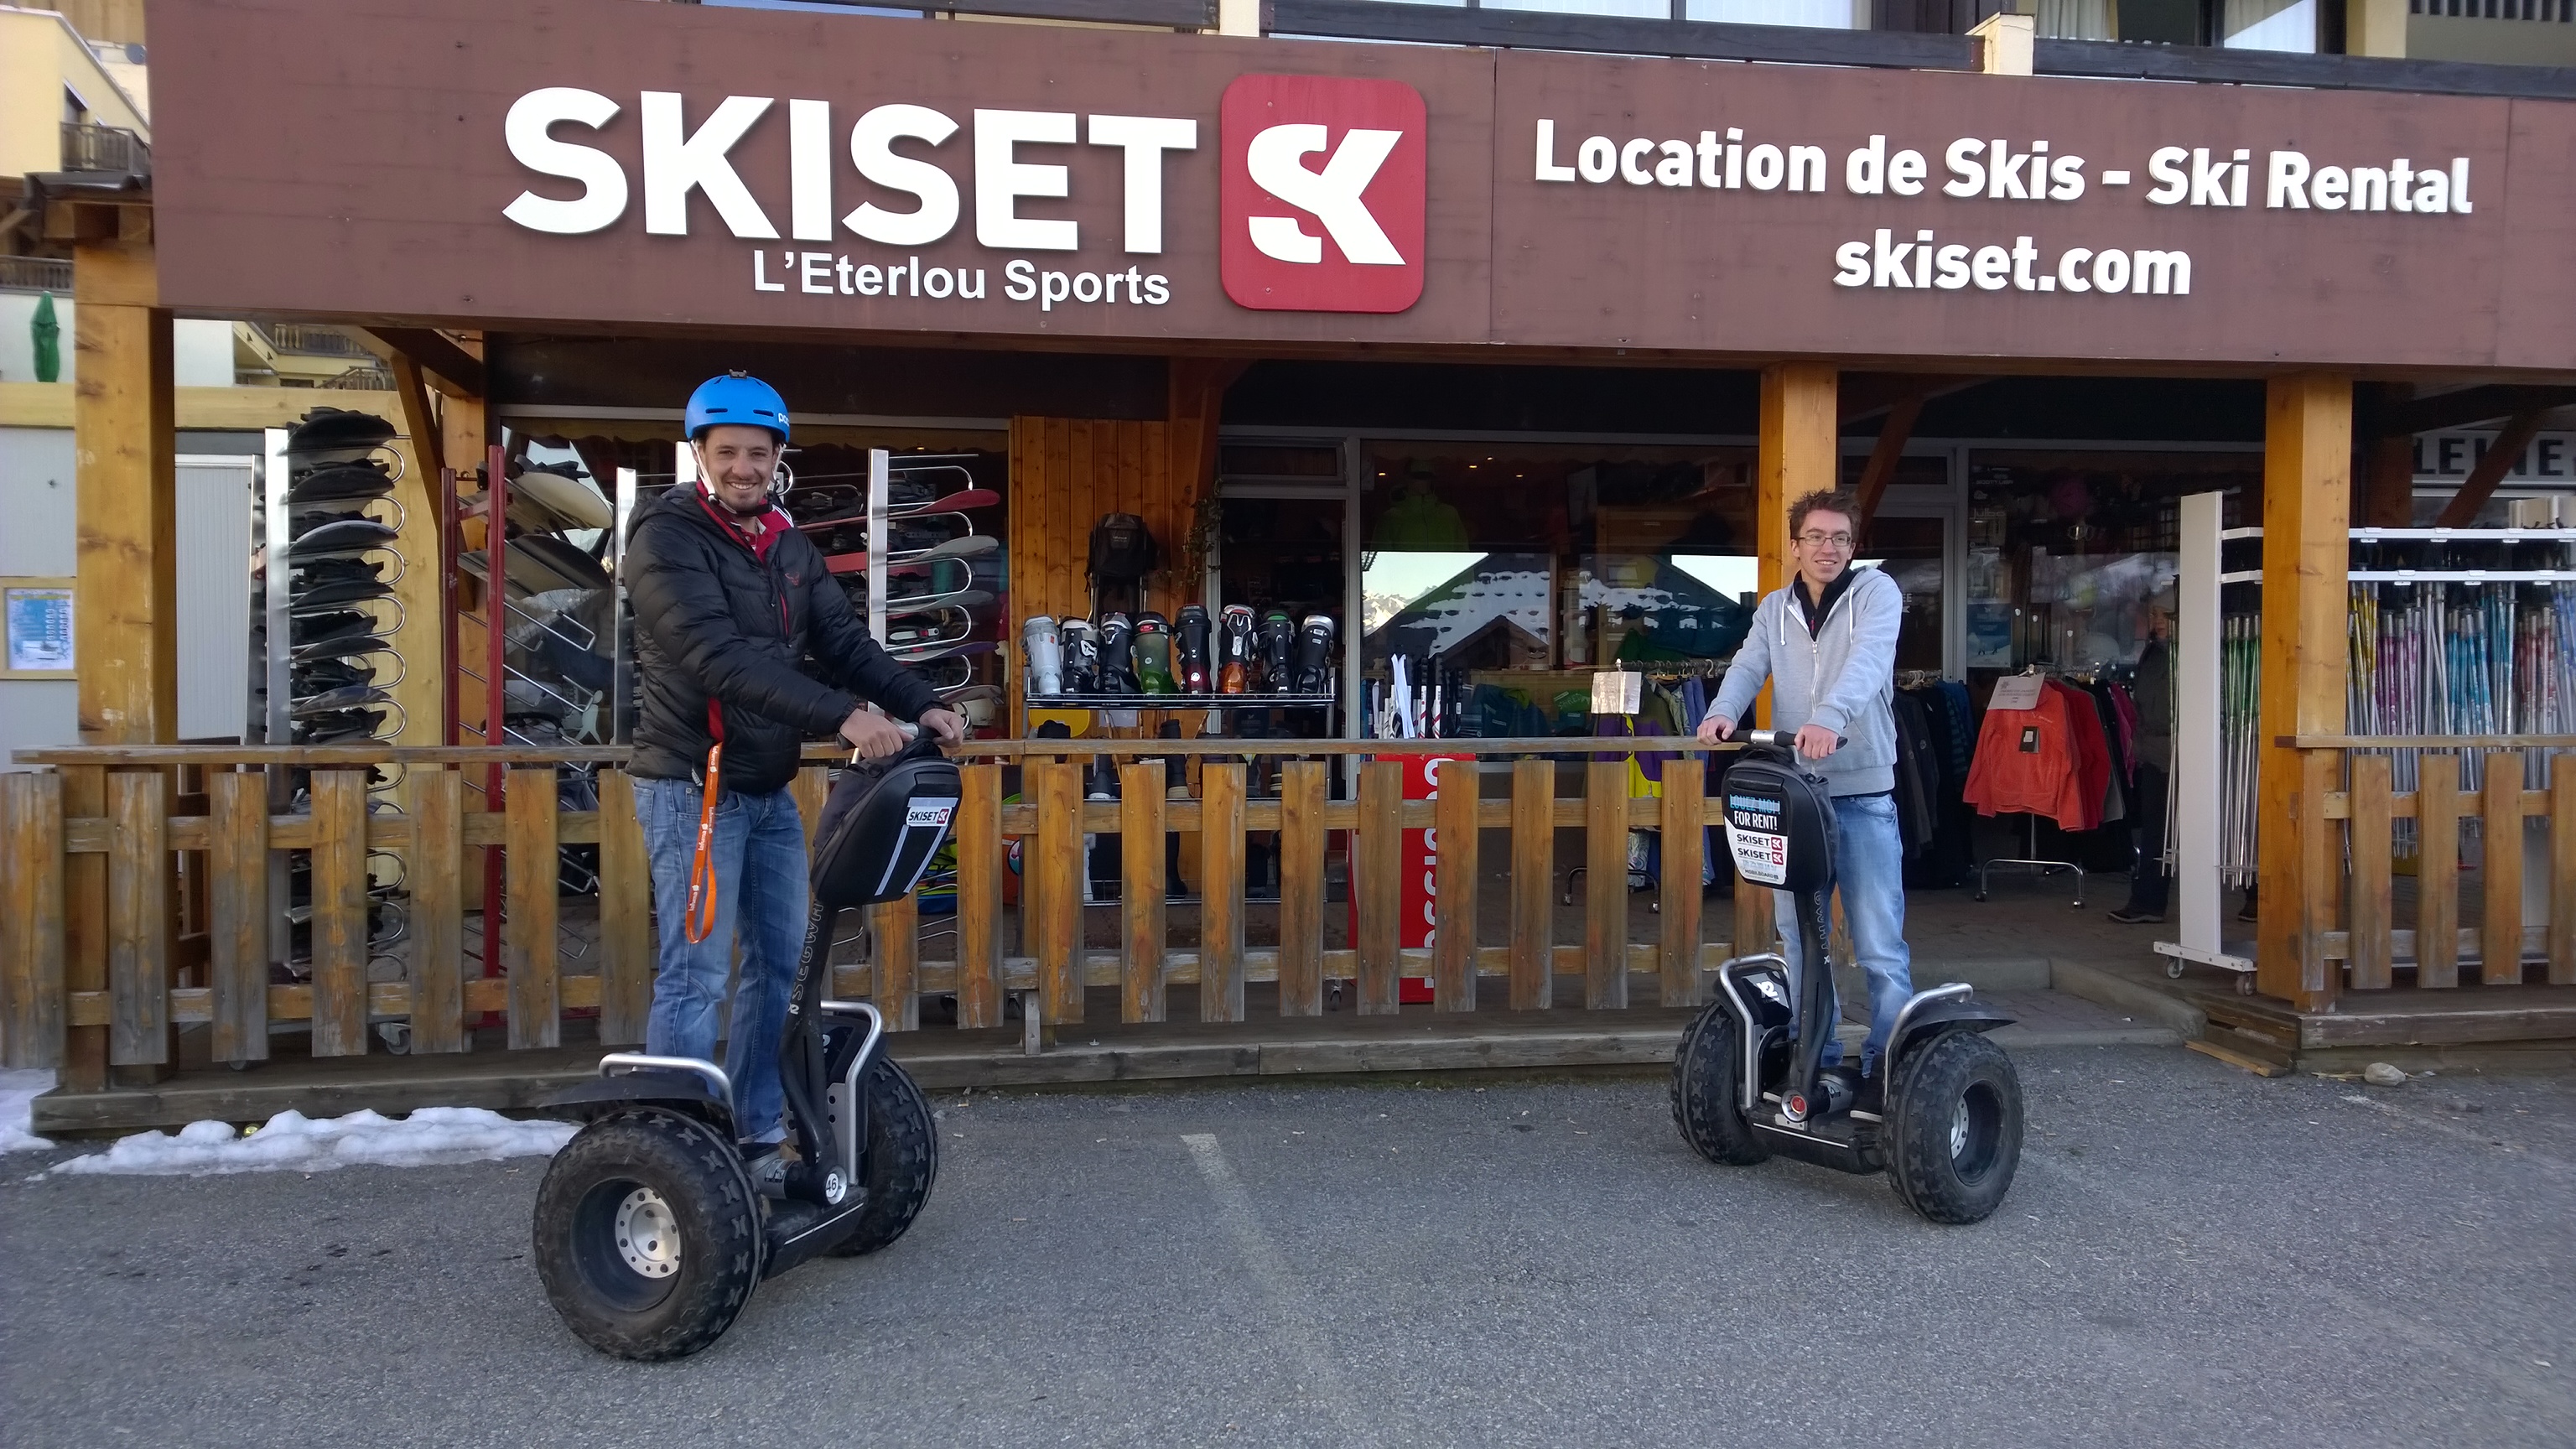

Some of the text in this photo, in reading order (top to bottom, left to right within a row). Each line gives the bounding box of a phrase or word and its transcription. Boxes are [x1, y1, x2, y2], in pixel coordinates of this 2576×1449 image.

[501, 86, 1197, 255] SKISET
[1535, 118, 1828, 192] Location
[1846, 134, 1928, 196] de
[1941, 137, 2086, 201] Skis
[2145, 146, 2251, 208] Ski
[2266, 150, 2474, 214] Rental
[1832, 228, 2191, 296] skiset.com
[754, 249, 1171, 312] L'Eterlou Sports
[908, 812, 938, 821] SKISET
[1733, 810, 1778, 831] FOR RENT!
[1737, 834, 1770, 847] SKISET
[1737, 847, 1771, 861] SKISET
[826, 1177, 838, 1192] 46
